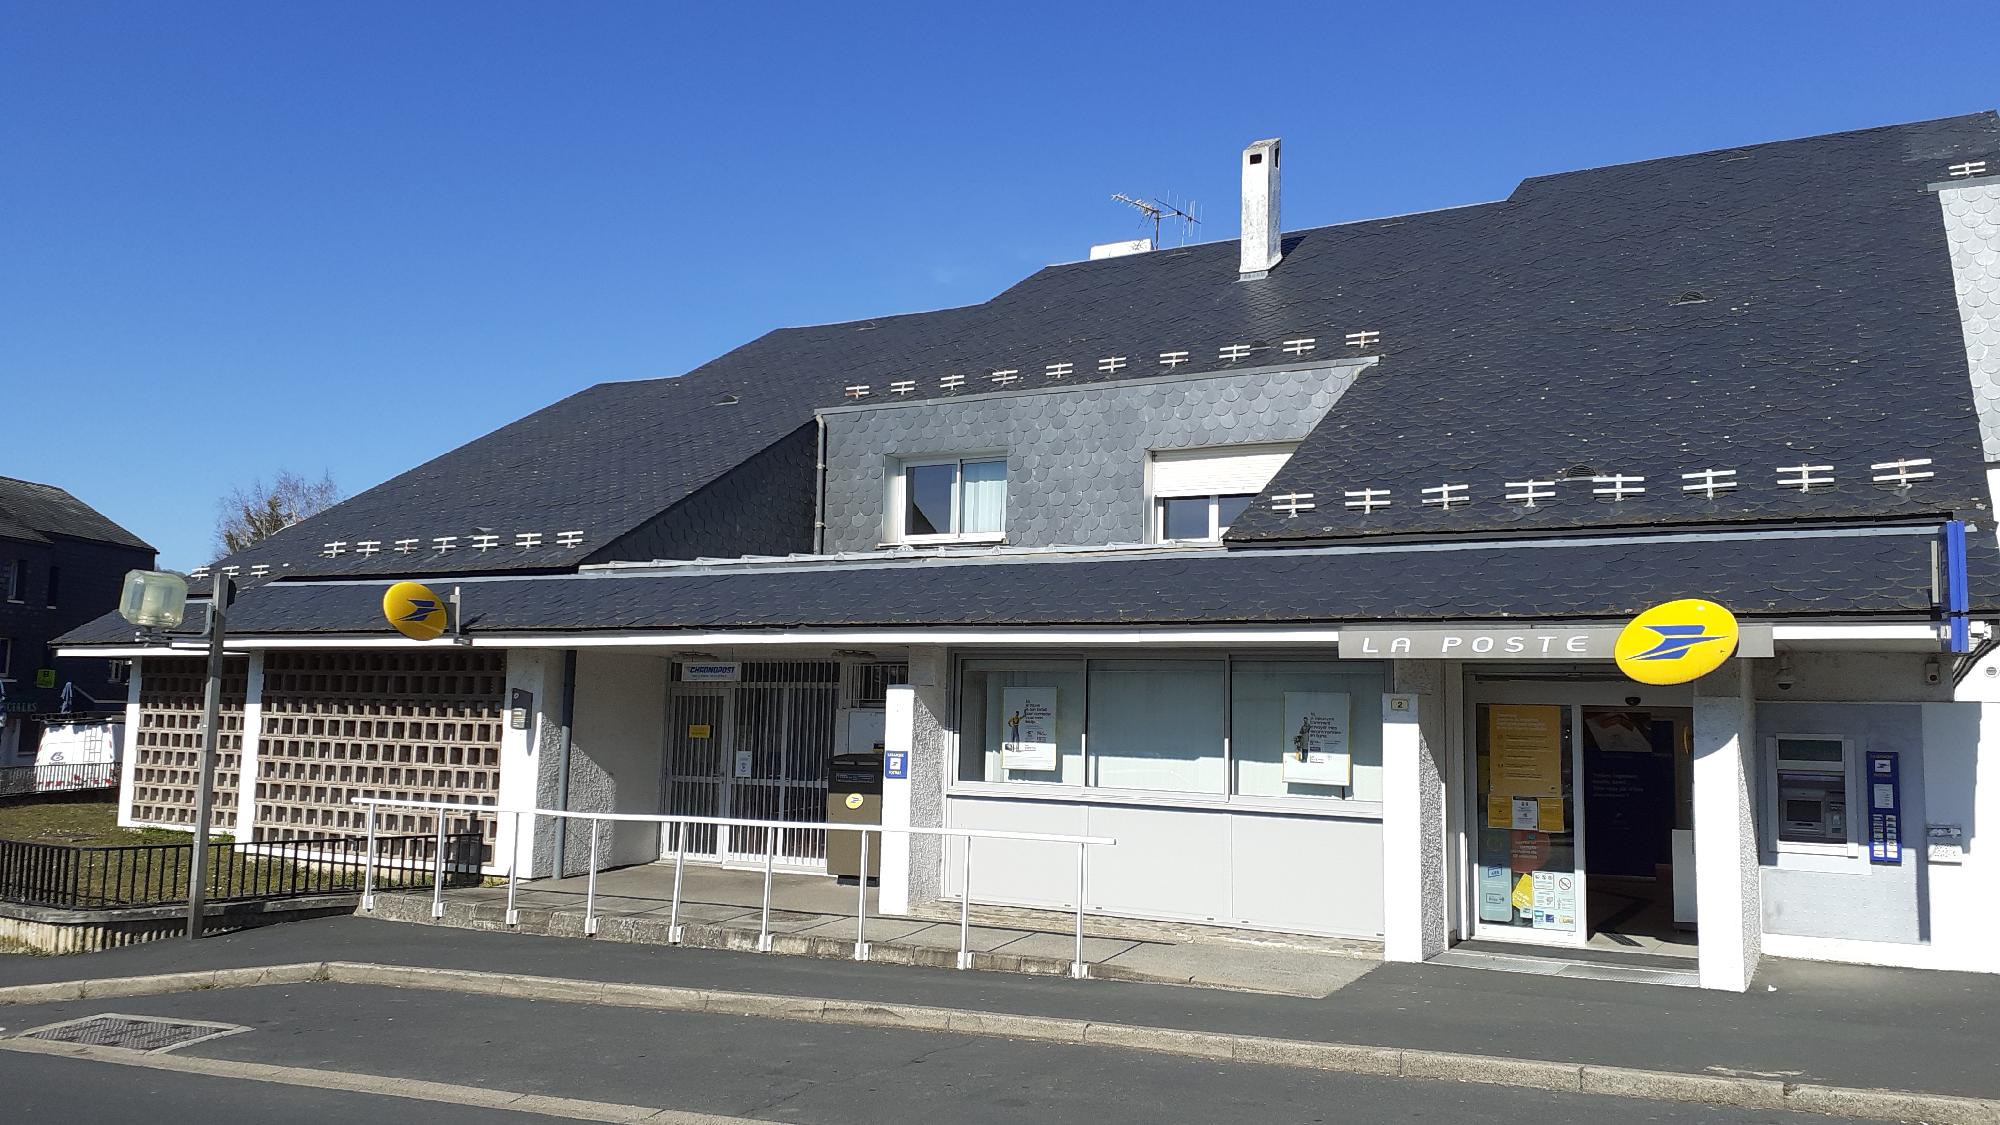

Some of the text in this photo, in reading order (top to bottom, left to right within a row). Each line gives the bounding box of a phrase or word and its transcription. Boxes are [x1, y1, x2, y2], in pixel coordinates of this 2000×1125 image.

[1362, 635, 1590, 653] LA POSTE
[690, 666, 735, 674] CHRONOPOST
